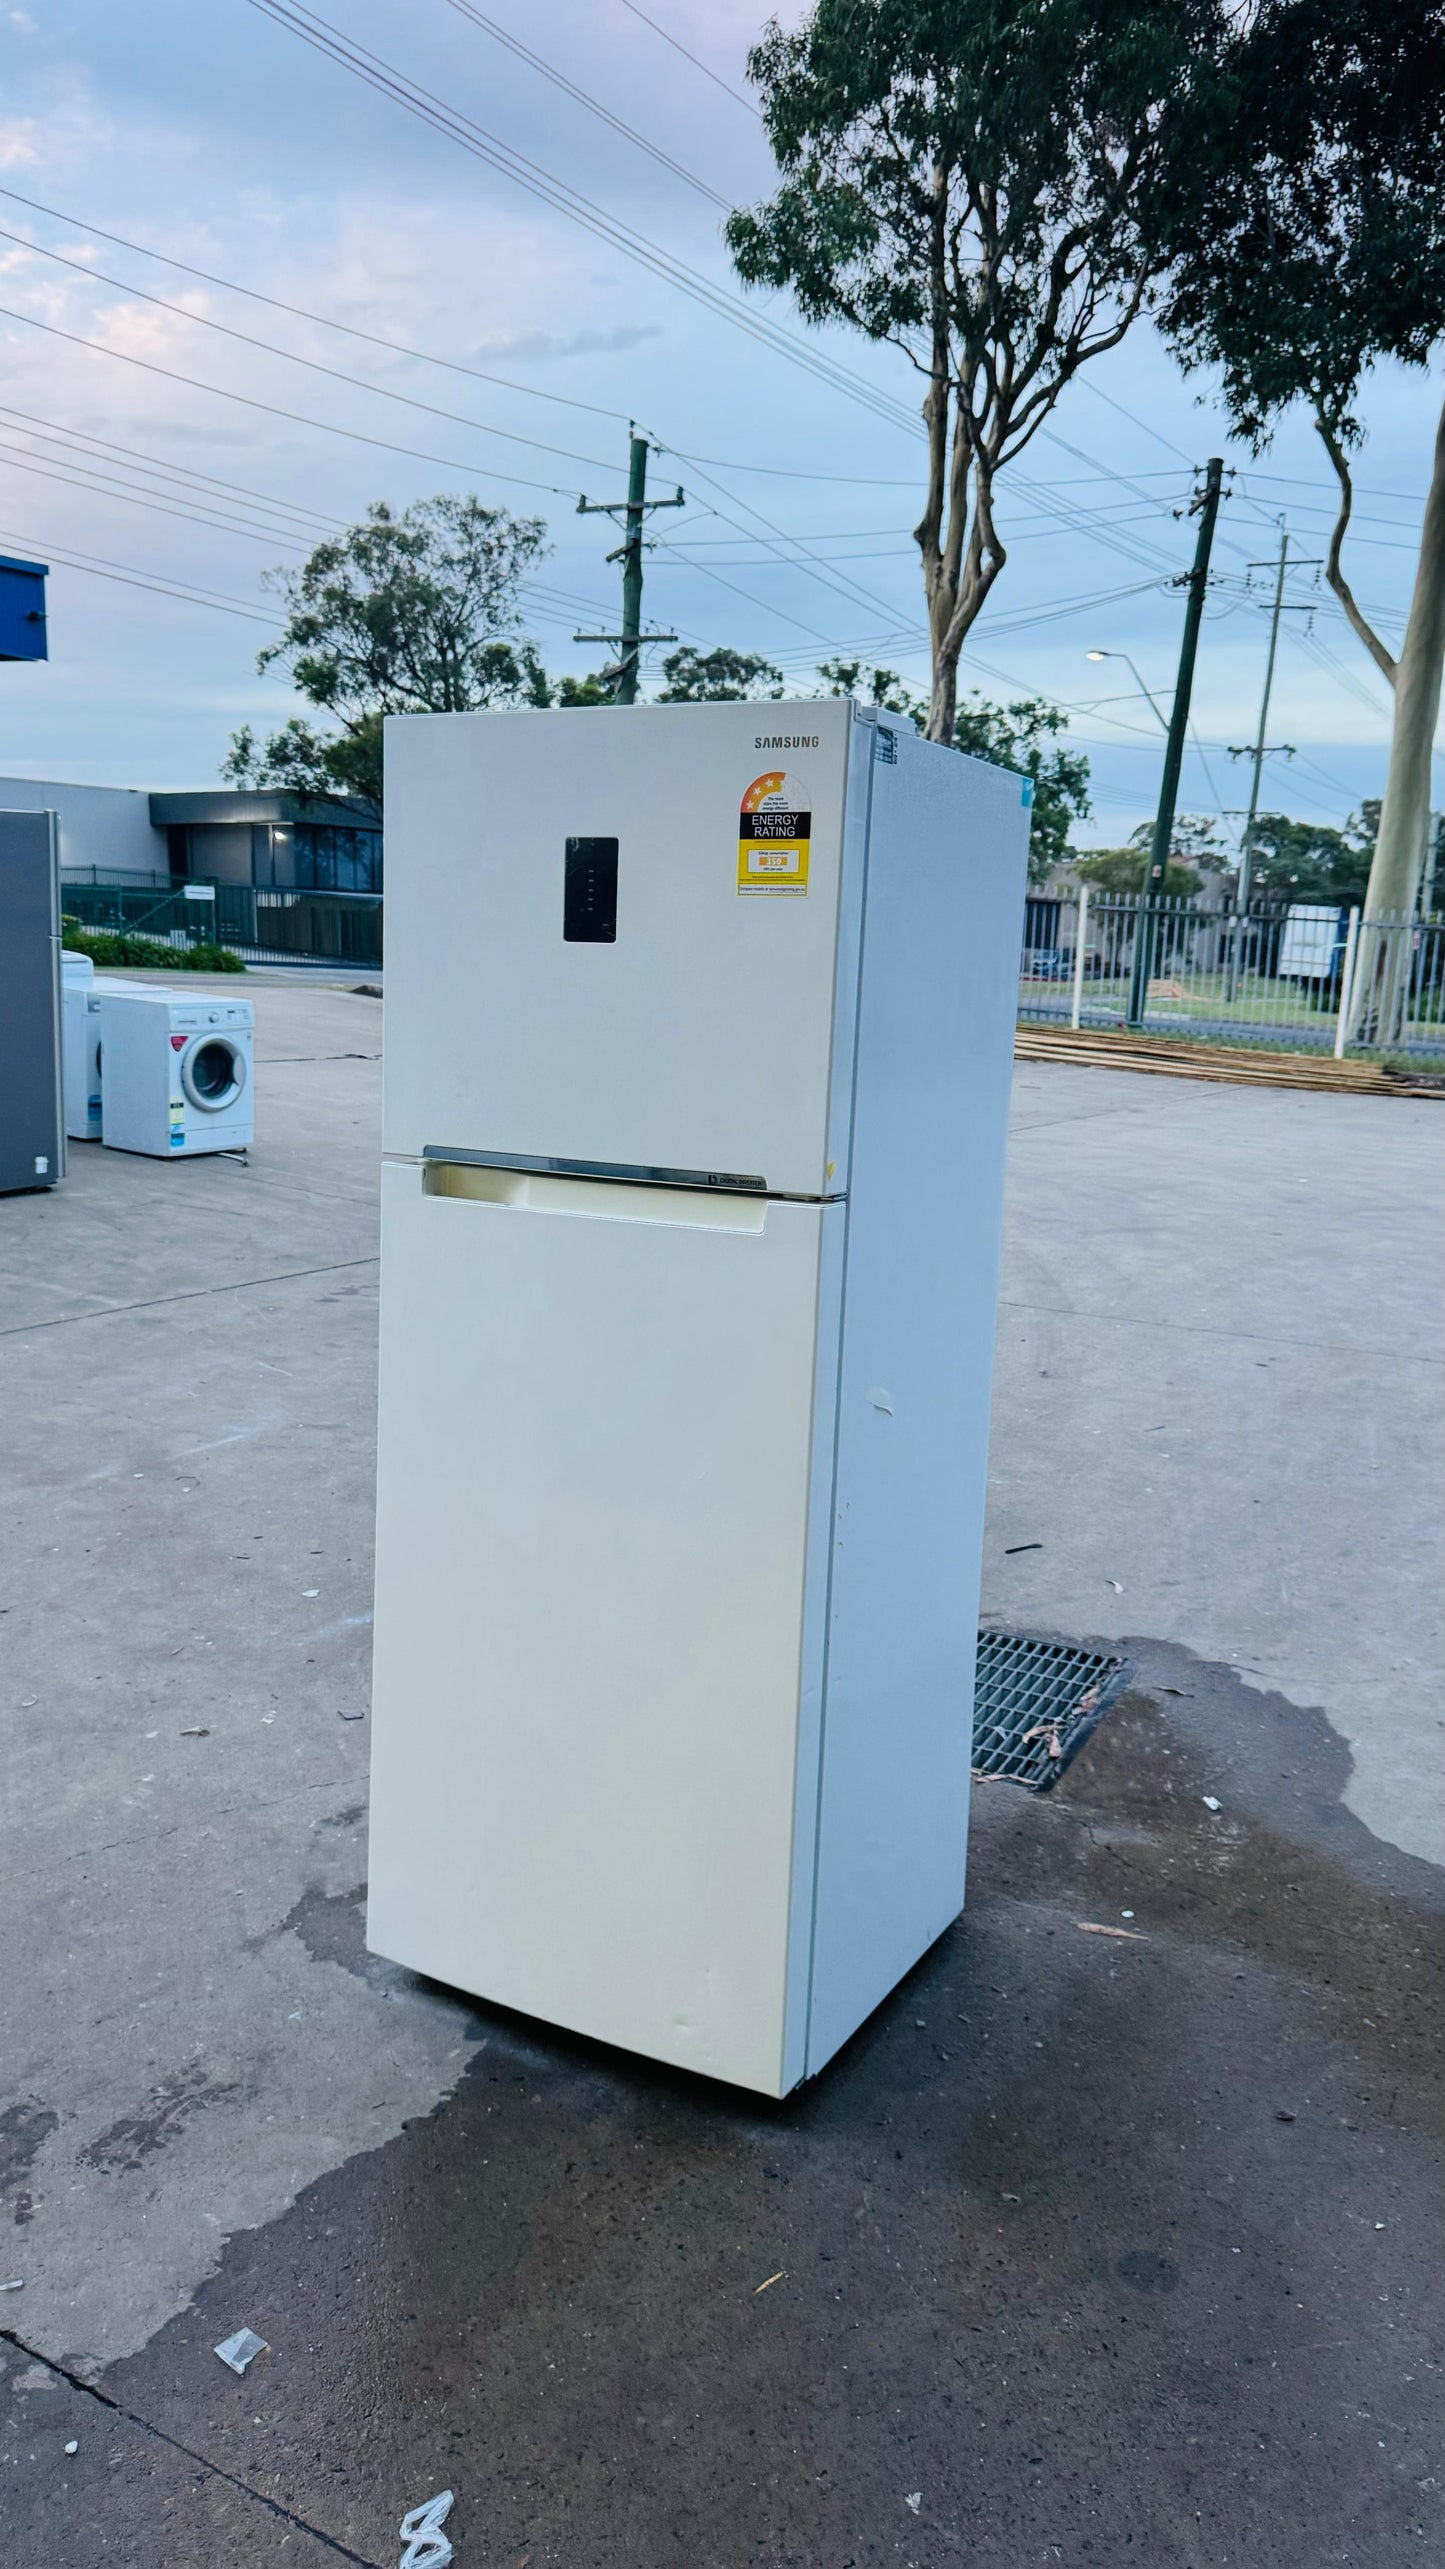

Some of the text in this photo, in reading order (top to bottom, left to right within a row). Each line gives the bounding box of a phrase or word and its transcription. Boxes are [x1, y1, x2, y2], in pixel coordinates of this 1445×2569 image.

[754, 736, 819, 749] SAMSUNG
[751, 814, 799, 826] ENERGY
[754, 826, 796, 837] RATING
